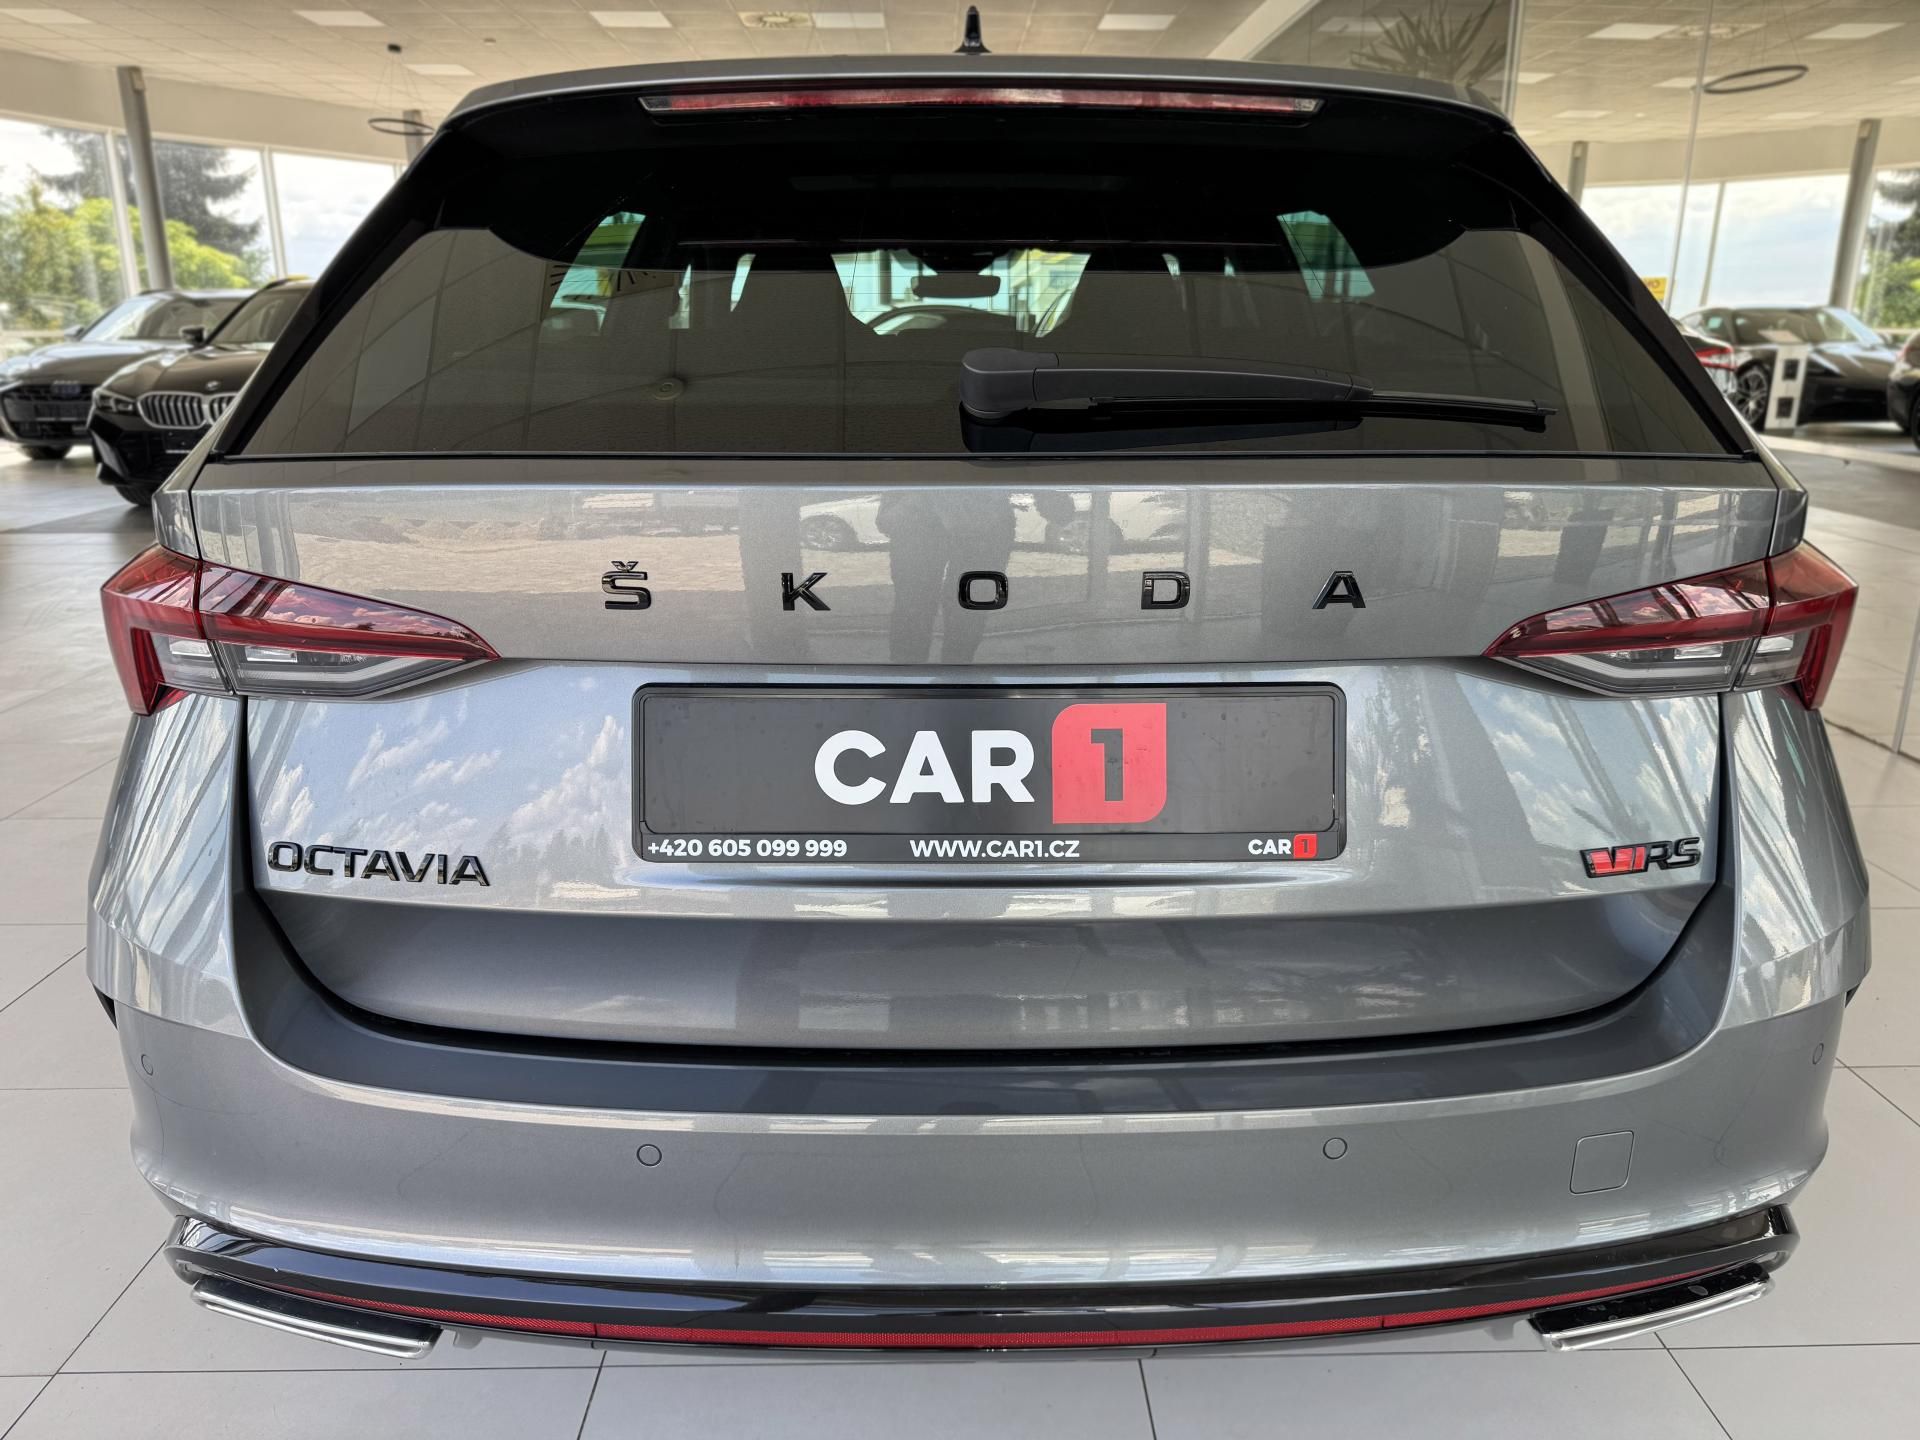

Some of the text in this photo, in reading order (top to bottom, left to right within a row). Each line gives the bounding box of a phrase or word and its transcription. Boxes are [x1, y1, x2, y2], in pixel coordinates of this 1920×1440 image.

[601, 560, 1367, 611] ŠKODA
[647, 838, 848, 857] +420 605 099 999
[909, 839, 1081, 858] WWW.CAR1.CZ
[267, 841, 491, 887] OCTAVIA
